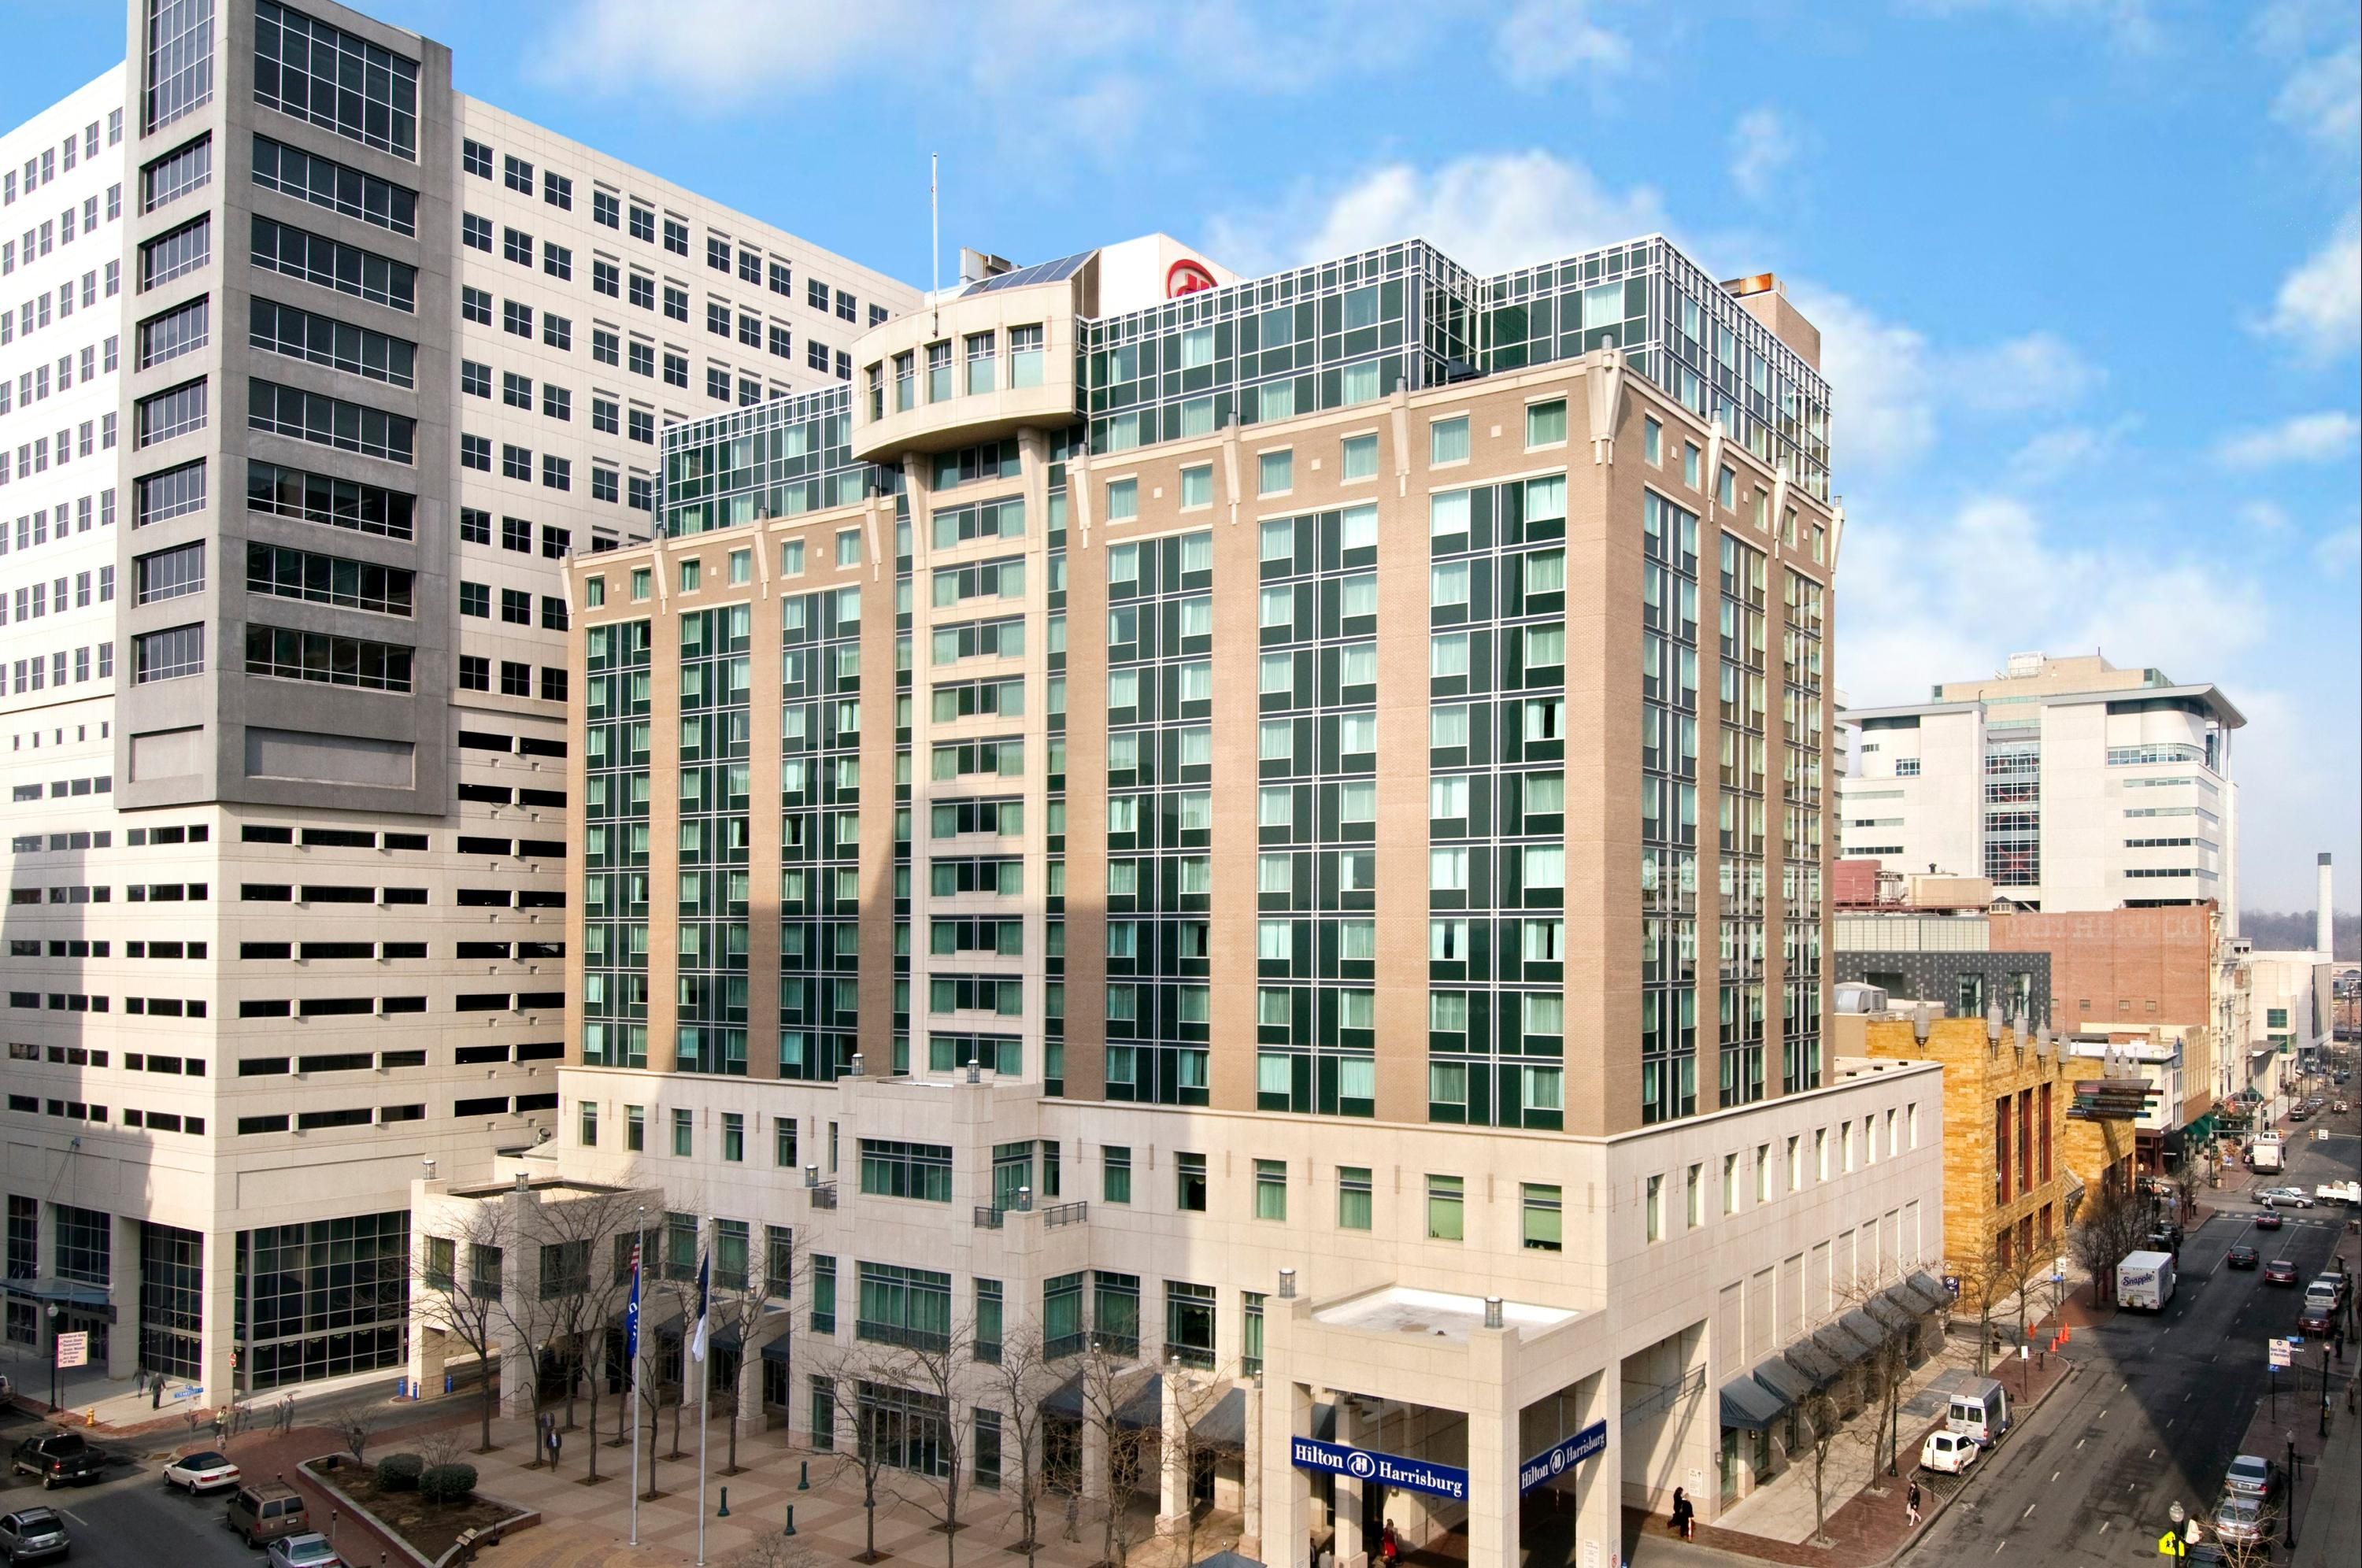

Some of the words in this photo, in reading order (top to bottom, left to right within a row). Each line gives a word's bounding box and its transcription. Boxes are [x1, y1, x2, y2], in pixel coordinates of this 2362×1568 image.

[2123, 1272, 2153, 1286] Snapple
[1294, 1444, 1343, 1469] Hilton
[1379, 1461, 1462, 1497] Harrisburg
[1521, 1464, 1549, 1489] Hilton
[1566, 1433, 1605, 1463] Harrisburg
